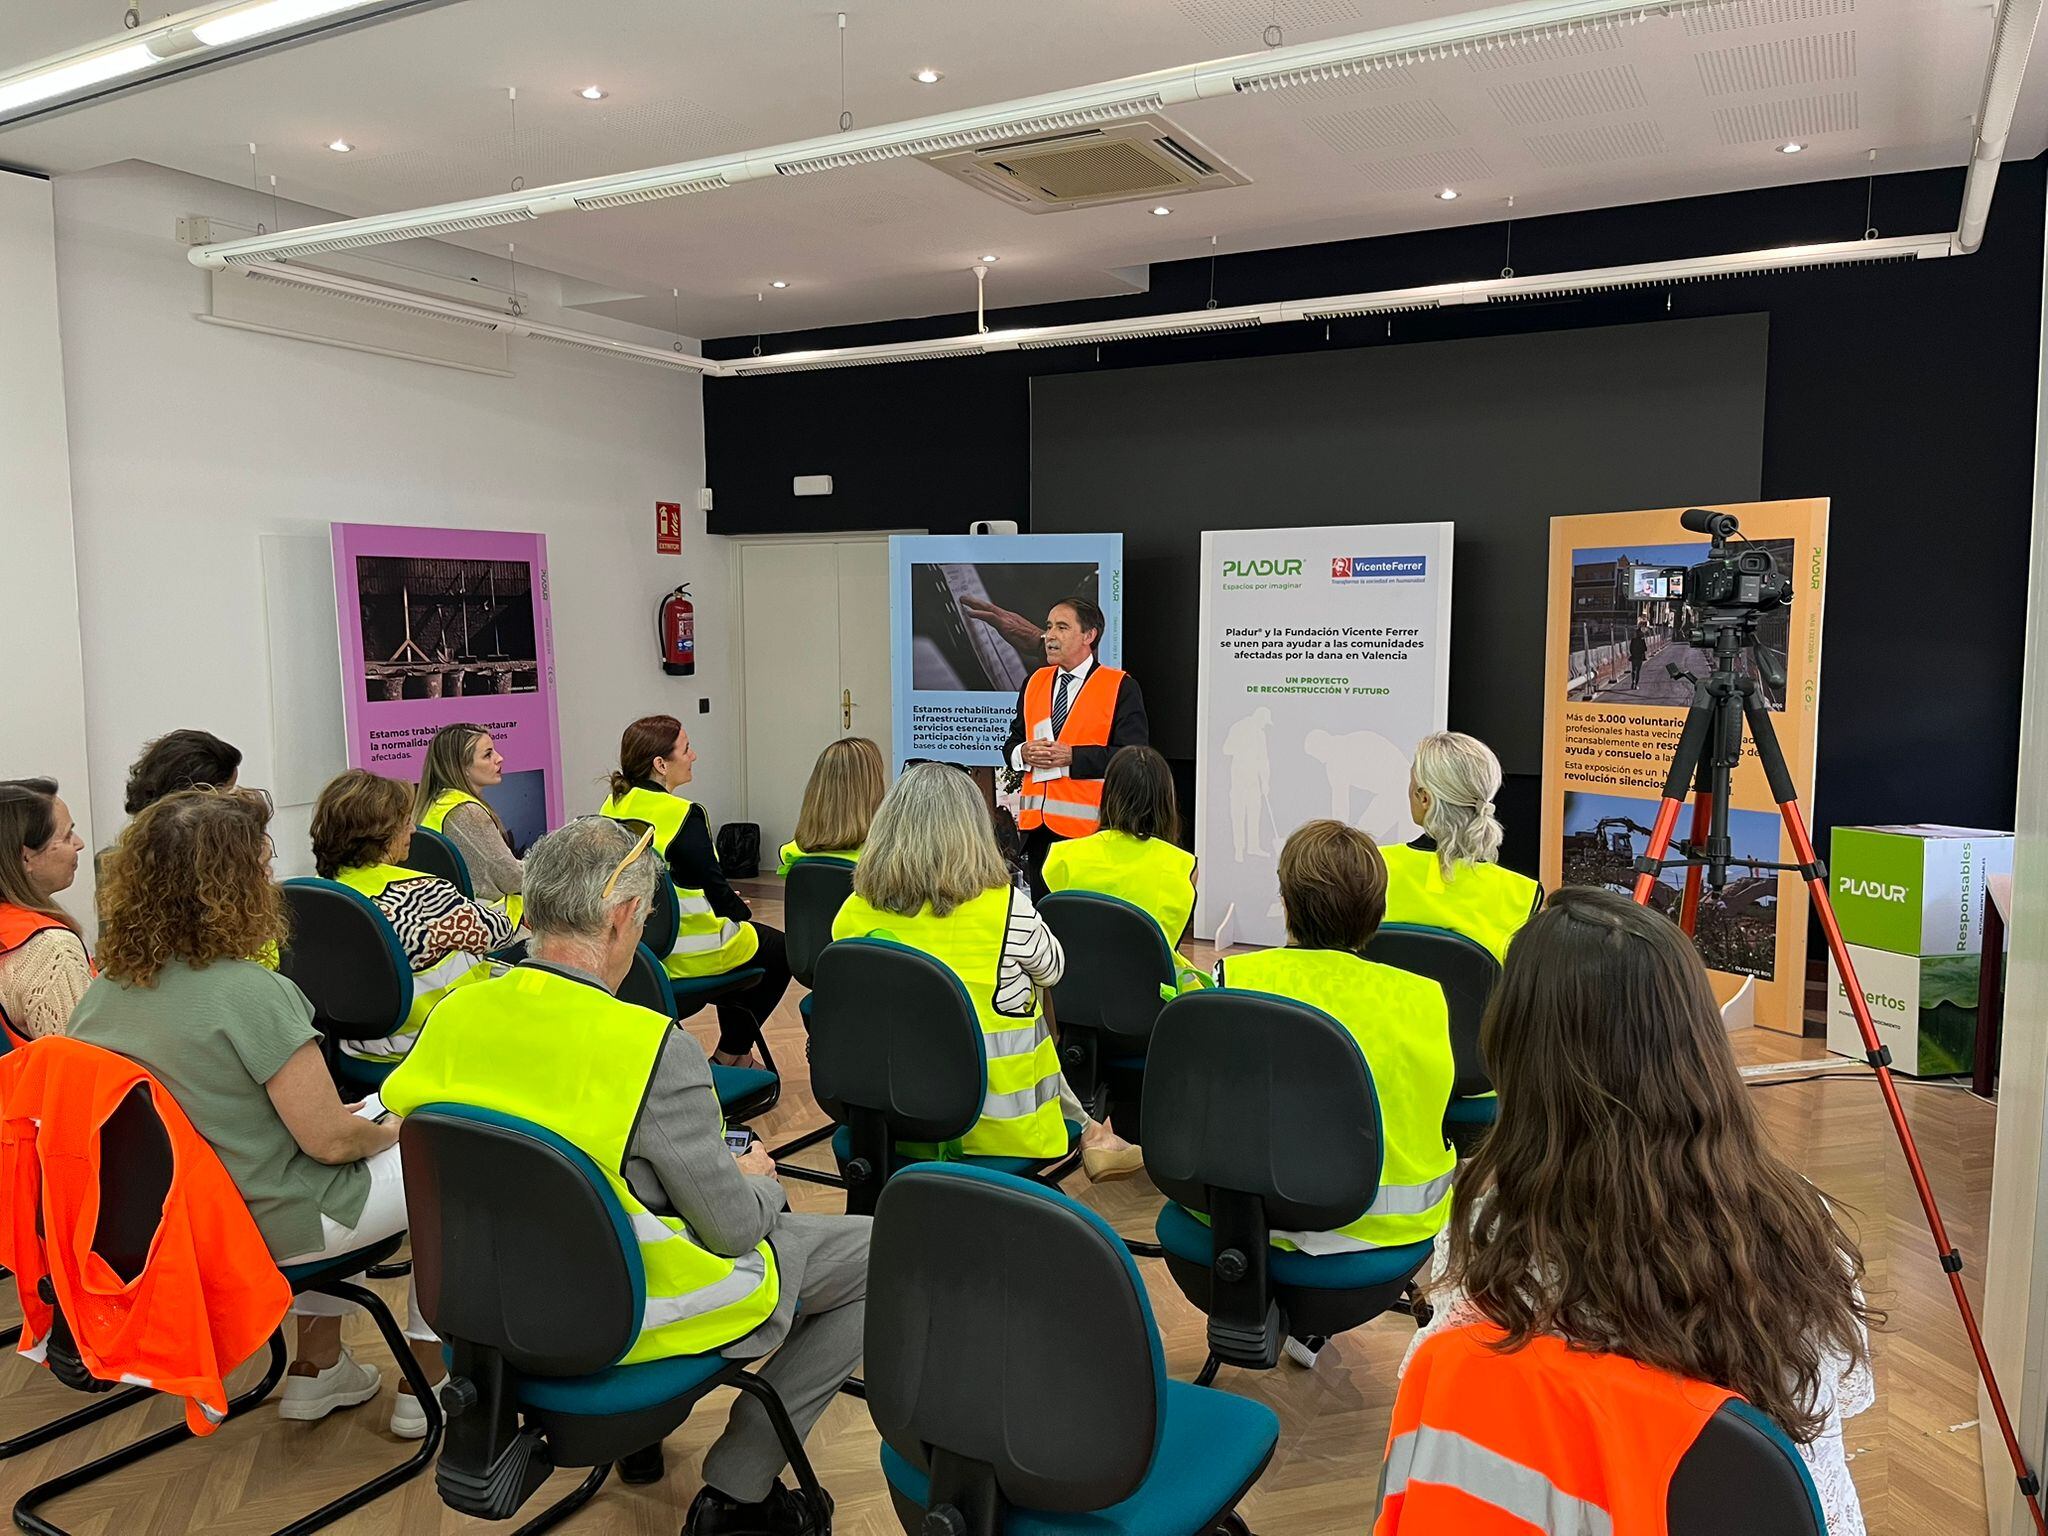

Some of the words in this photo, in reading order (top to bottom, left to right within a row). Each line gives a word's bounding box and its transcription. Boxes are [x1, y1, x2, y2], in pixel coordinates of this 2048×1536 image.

[1223, 559, 1303, 577] PLADUR
[1355, 561, 1422, 571] VicenteFerrer
[1811, 547, 1821, 590] PLADUR
[1223, 583, 1253, 591] Espacios
[1269, 582, 1302, 590] imaginar
[1264, 630, 1271, 638] y
[1273, 628, 1282, 636] la
[1285, 627, 1339, 636] Fundación
[1342, 627, 1383, 636] Vicente
[1386, 628, 1419, 636] Ferrer
[1261, 641, 1284, 649] para
[1286, 640, 1322, 650] ayudar
[1333, 640, 1348, 648] las
[1350, 639, 1424, 648] comunidades
[1234, 650, 1283, 659] afectadas
[1285, 652, 1303, 661] por
[1305, 651, 1315, 659] la
[1317, 651, 1343, 659] dana
[1362, 651, 1408, 660] Valencia
[1300, 677, 1349, 685] PROYECTO
[1261, 686, 1341, 694] RECONSTRUCCIÓN
[913, 705, 952, 714] Estamos
[954, 706, 1017, 715] rehabilitando
[913, 714, 988, 723] infraestructuras
[989, 717, 1008, 725] para
[1566, 713, 1583, 722] Más
[1585, 714, 1596, 722] de
[1598, 714, 1626, 724] 3.000
[1628, 716, 1684, 728] voluntario
[913, 723, 954, 732] servicios
[956, 724, 1007, 734] esenciales,
[1566, 724, 1623, 736] profesionales
[1625, 728, 1650, 737] hasta
[1651, 730, 1682, 739] vecino
[369, 729, 410, 740] Estamos
[913, 733, 974, 742] participación
[983, 734, 989, 742] la
[370, 742, 379, 751] la
[913, 742, 936, 750] bases
[949, 743, 991, 751] cohesión
[1565, 735, 1640, 748] incansablemente
[1642, 741, 1654, 749] en
[1565, 746, 1595, 756] ayuda
[1605, 749, 1652, 760] consuelo
[1565, 761, 1582, 770] Esta
[1584, 762, 1631, 774] exposición
[1633, 768, 1643, 776] es
[1564, 772, 1617, 785] revolución
[1619, 776, 1665, 789] silencios
[1839, 877, 1907, 904] PLADUR
[1956, 842, 1971, 951] Responsables
[1839, 983, 1906, 1012] Eertos
